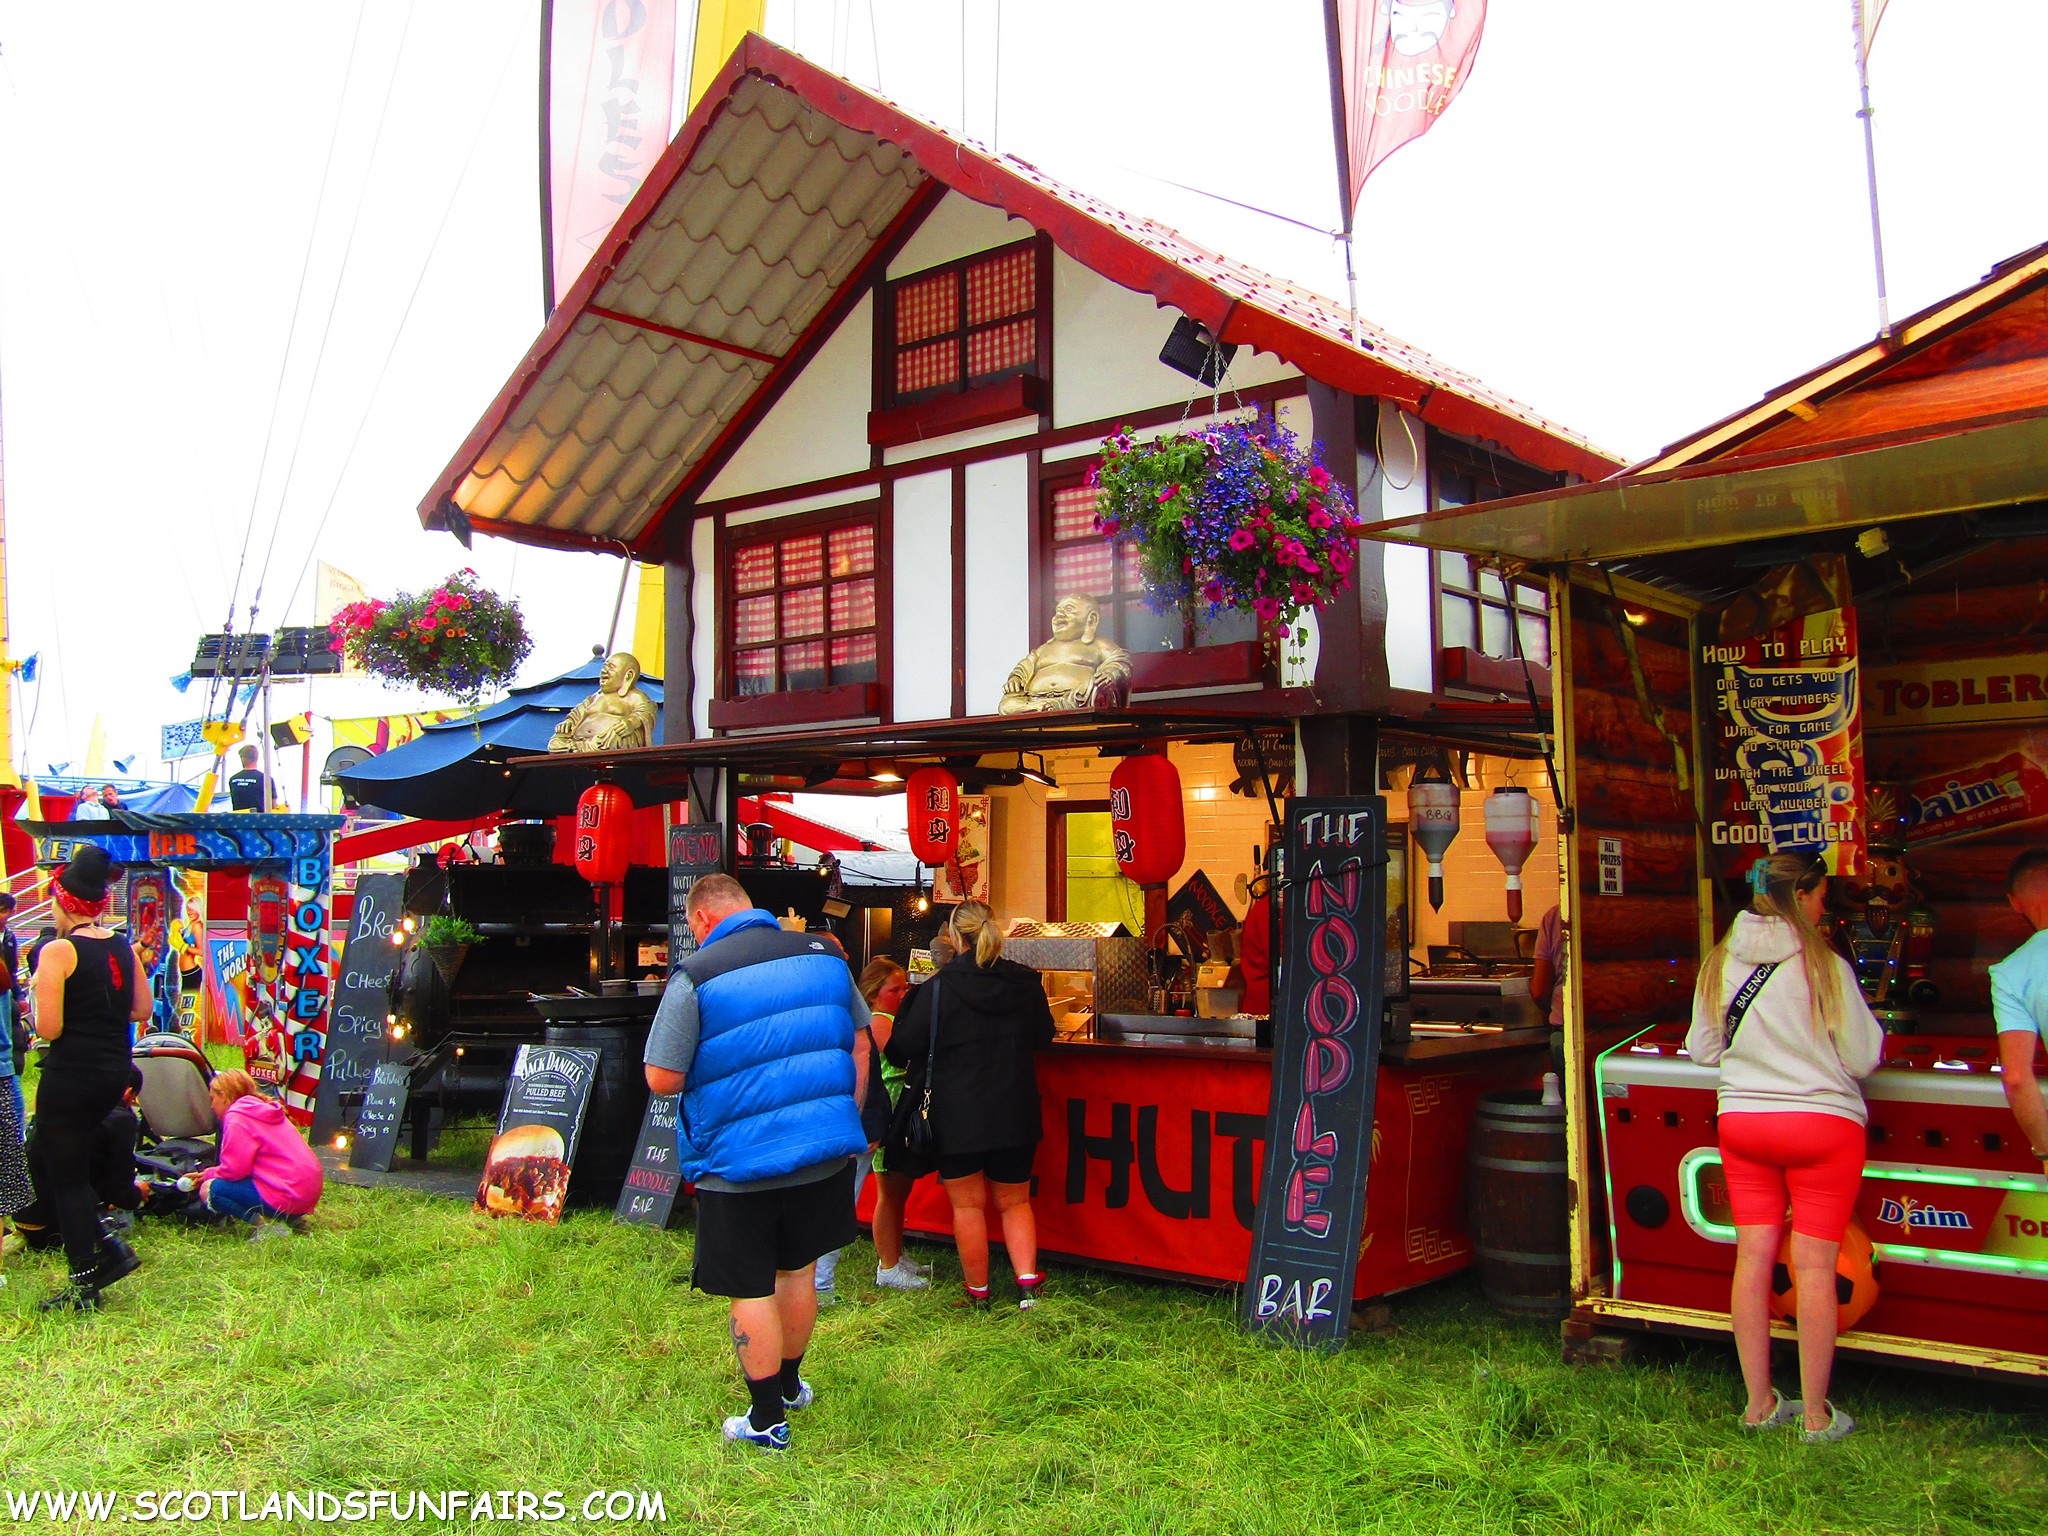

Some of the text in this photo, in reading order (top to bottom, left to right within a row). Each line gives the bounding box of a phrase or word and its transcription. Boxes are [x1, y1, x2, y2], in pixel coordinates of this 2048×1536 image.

[1702, 636, 1847, 664] HOW TO PLAY
[1717, 672, 1836, 691] ONE GO GETS YOU
[1718, 693, 1838, 711] 3 LUCKY NUMBERS
[1877, 674, 2048, 716] TOBLER
[1725, 722, 1832, 738] WAIT FOR GAME
[1743, 739, 1805, 753] TO START
[1715, 764, 1846, 780] WATCH THE WHEEL
[1750, 782, 1811, 795] FOR YOUR
[1734, 798, 1829, 811] LUCKY NUMBER
[1426, 809, 1452, 821] BBQ
[1300, 811, 1369, 847] THE
[1711, 821, 1854, 845] GOOD LUCK
[672, 832, 720, 865] MENU
[1604, 841, 1614, 852] ALL
[1600, 854, 1621, 866] PRIZES
[1604, 868, 1616, 878] ONE
[1604, 881, 1617, 891] WIN
[217, 941, 235, 966] THE
[294, 857, 323, 1062] BOXER
[1283, 856, 1362, 1239] NOODLE
[250, 1066, 277, 1079] BOXER
[520, 1051, 584, 1084] JACK DANIEL'S
[525, 1088, 567, 1098] PULLED BEEF
[650, 1099, 669, 1113] COLD
[646, 1145, 669, 1163] THE
[1065, 1098, 1267, 1231] HUT
[628, 1169, 674, 1192] NOODLE
[1257, 1274, 1333, 1322] BAR
